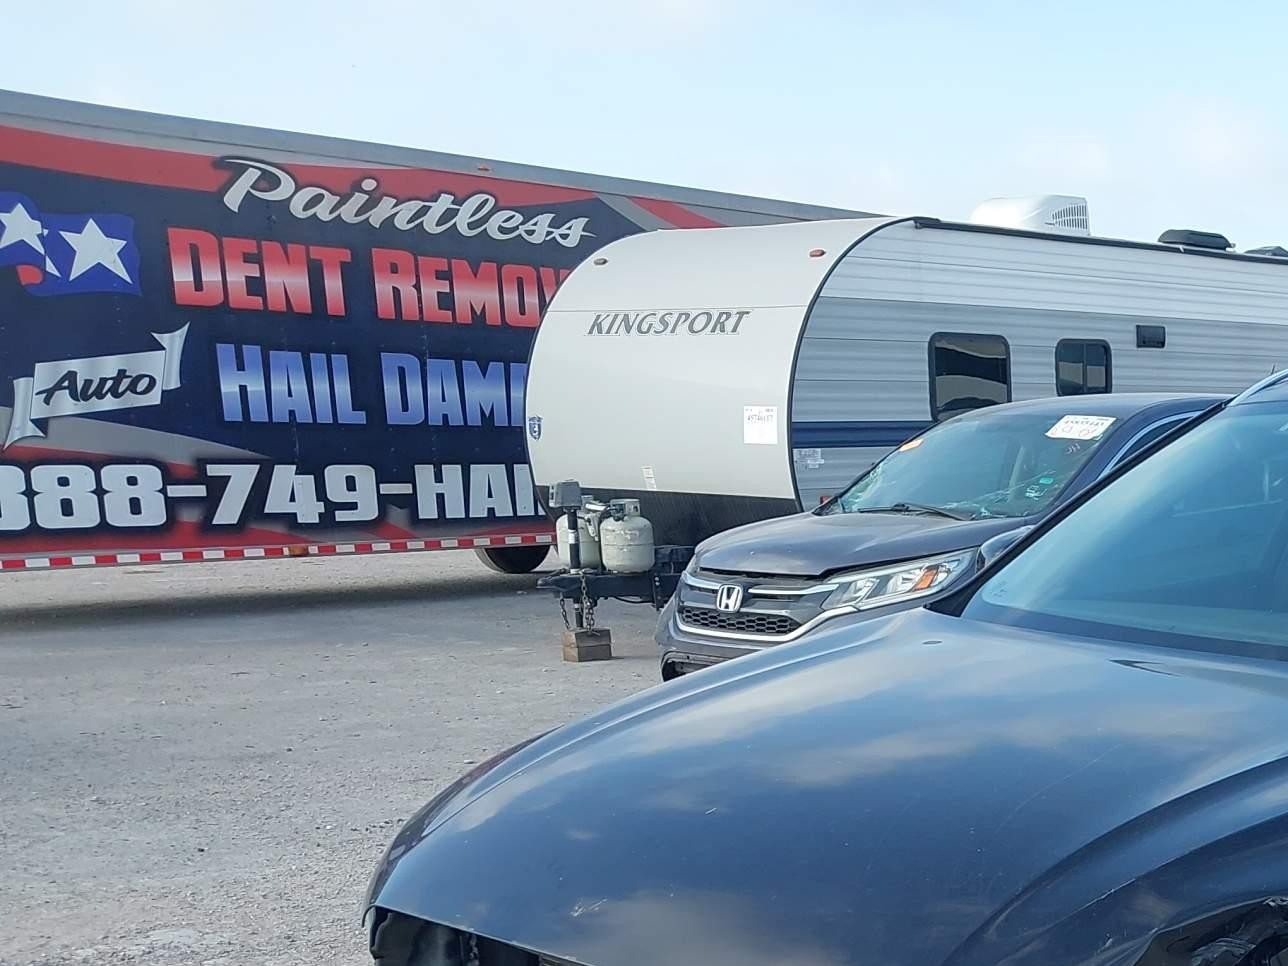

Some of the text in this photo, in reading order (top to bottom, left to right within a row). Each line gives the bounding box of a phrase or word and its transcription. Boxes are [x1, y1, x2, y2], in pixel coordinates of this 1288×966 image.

[223, 158, 597, 248] Paintless
[167, 227, 352, 317] DENT
[586, 311, 751, 336] KINGSPORT
[36, 368, 158, 404] Auto
[215, 343, 367, 426] HAIL
[0, 463, 546, 531] 88-749-HAI
